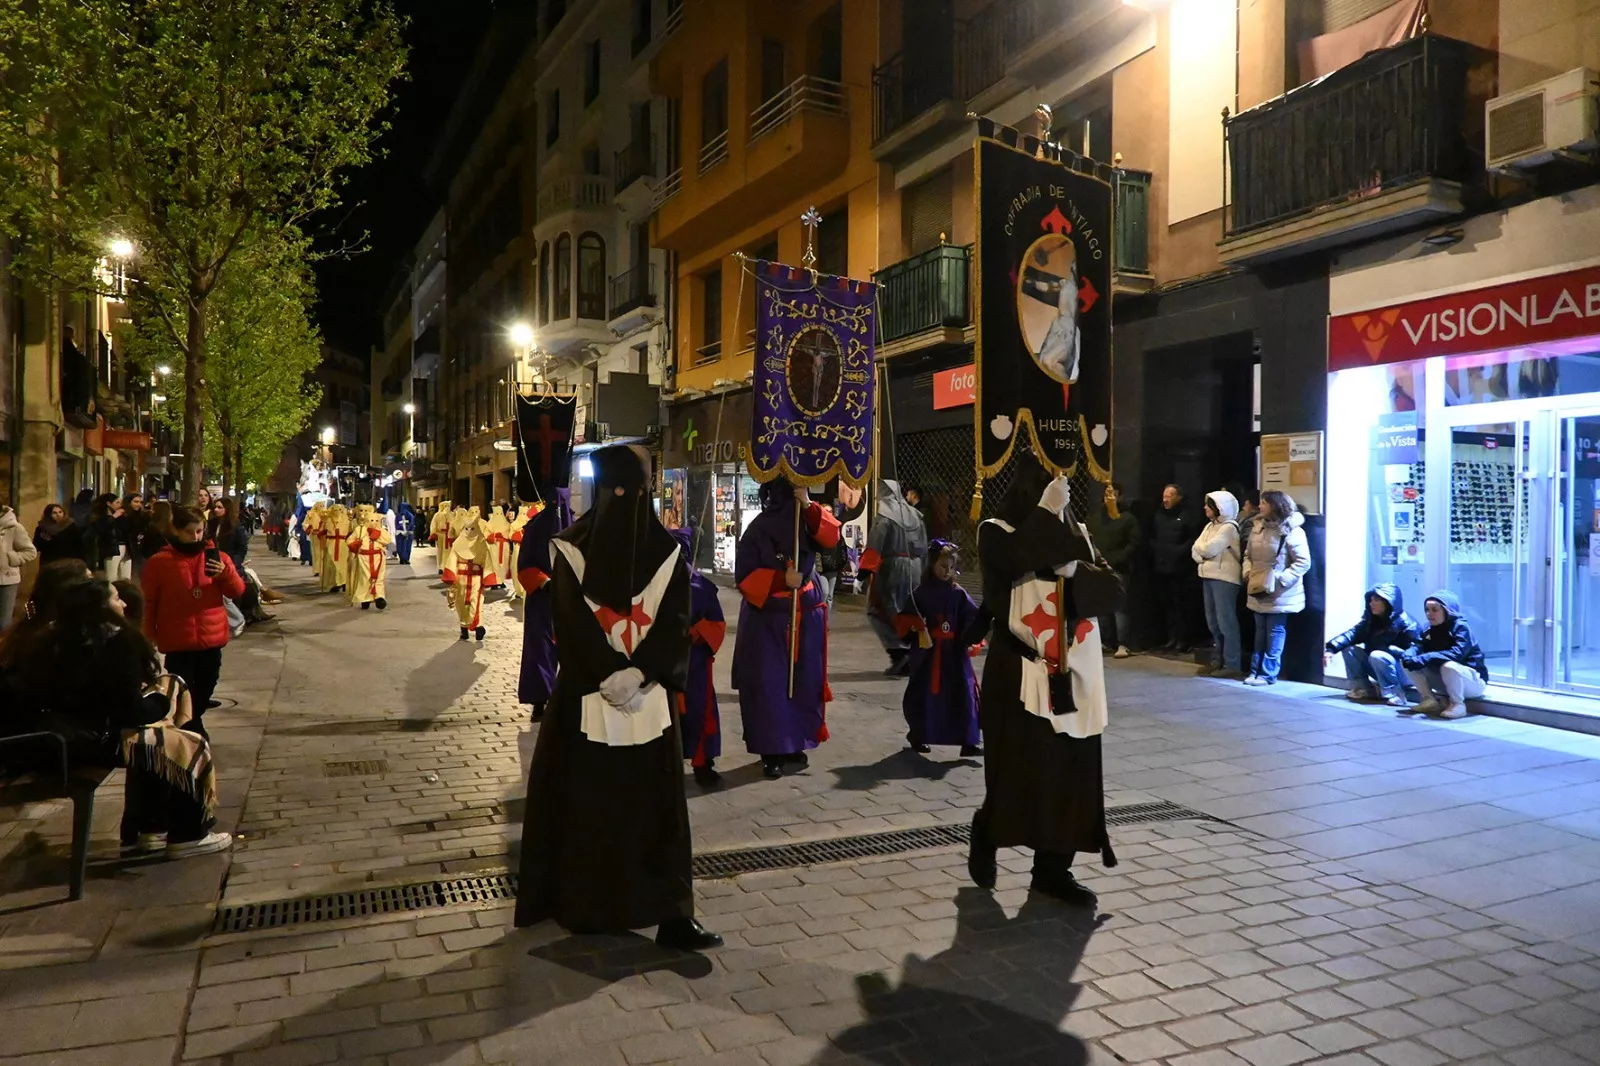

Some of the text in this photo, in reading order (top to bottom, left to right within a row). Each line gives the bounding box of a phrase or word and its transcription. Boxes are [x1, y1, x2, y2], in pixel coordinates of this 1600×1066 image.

[1049, 184, 1066, 199] DE
[1401, 282, 1600, 346] VISIONLAB
[950, 373, 975, 392] foto
